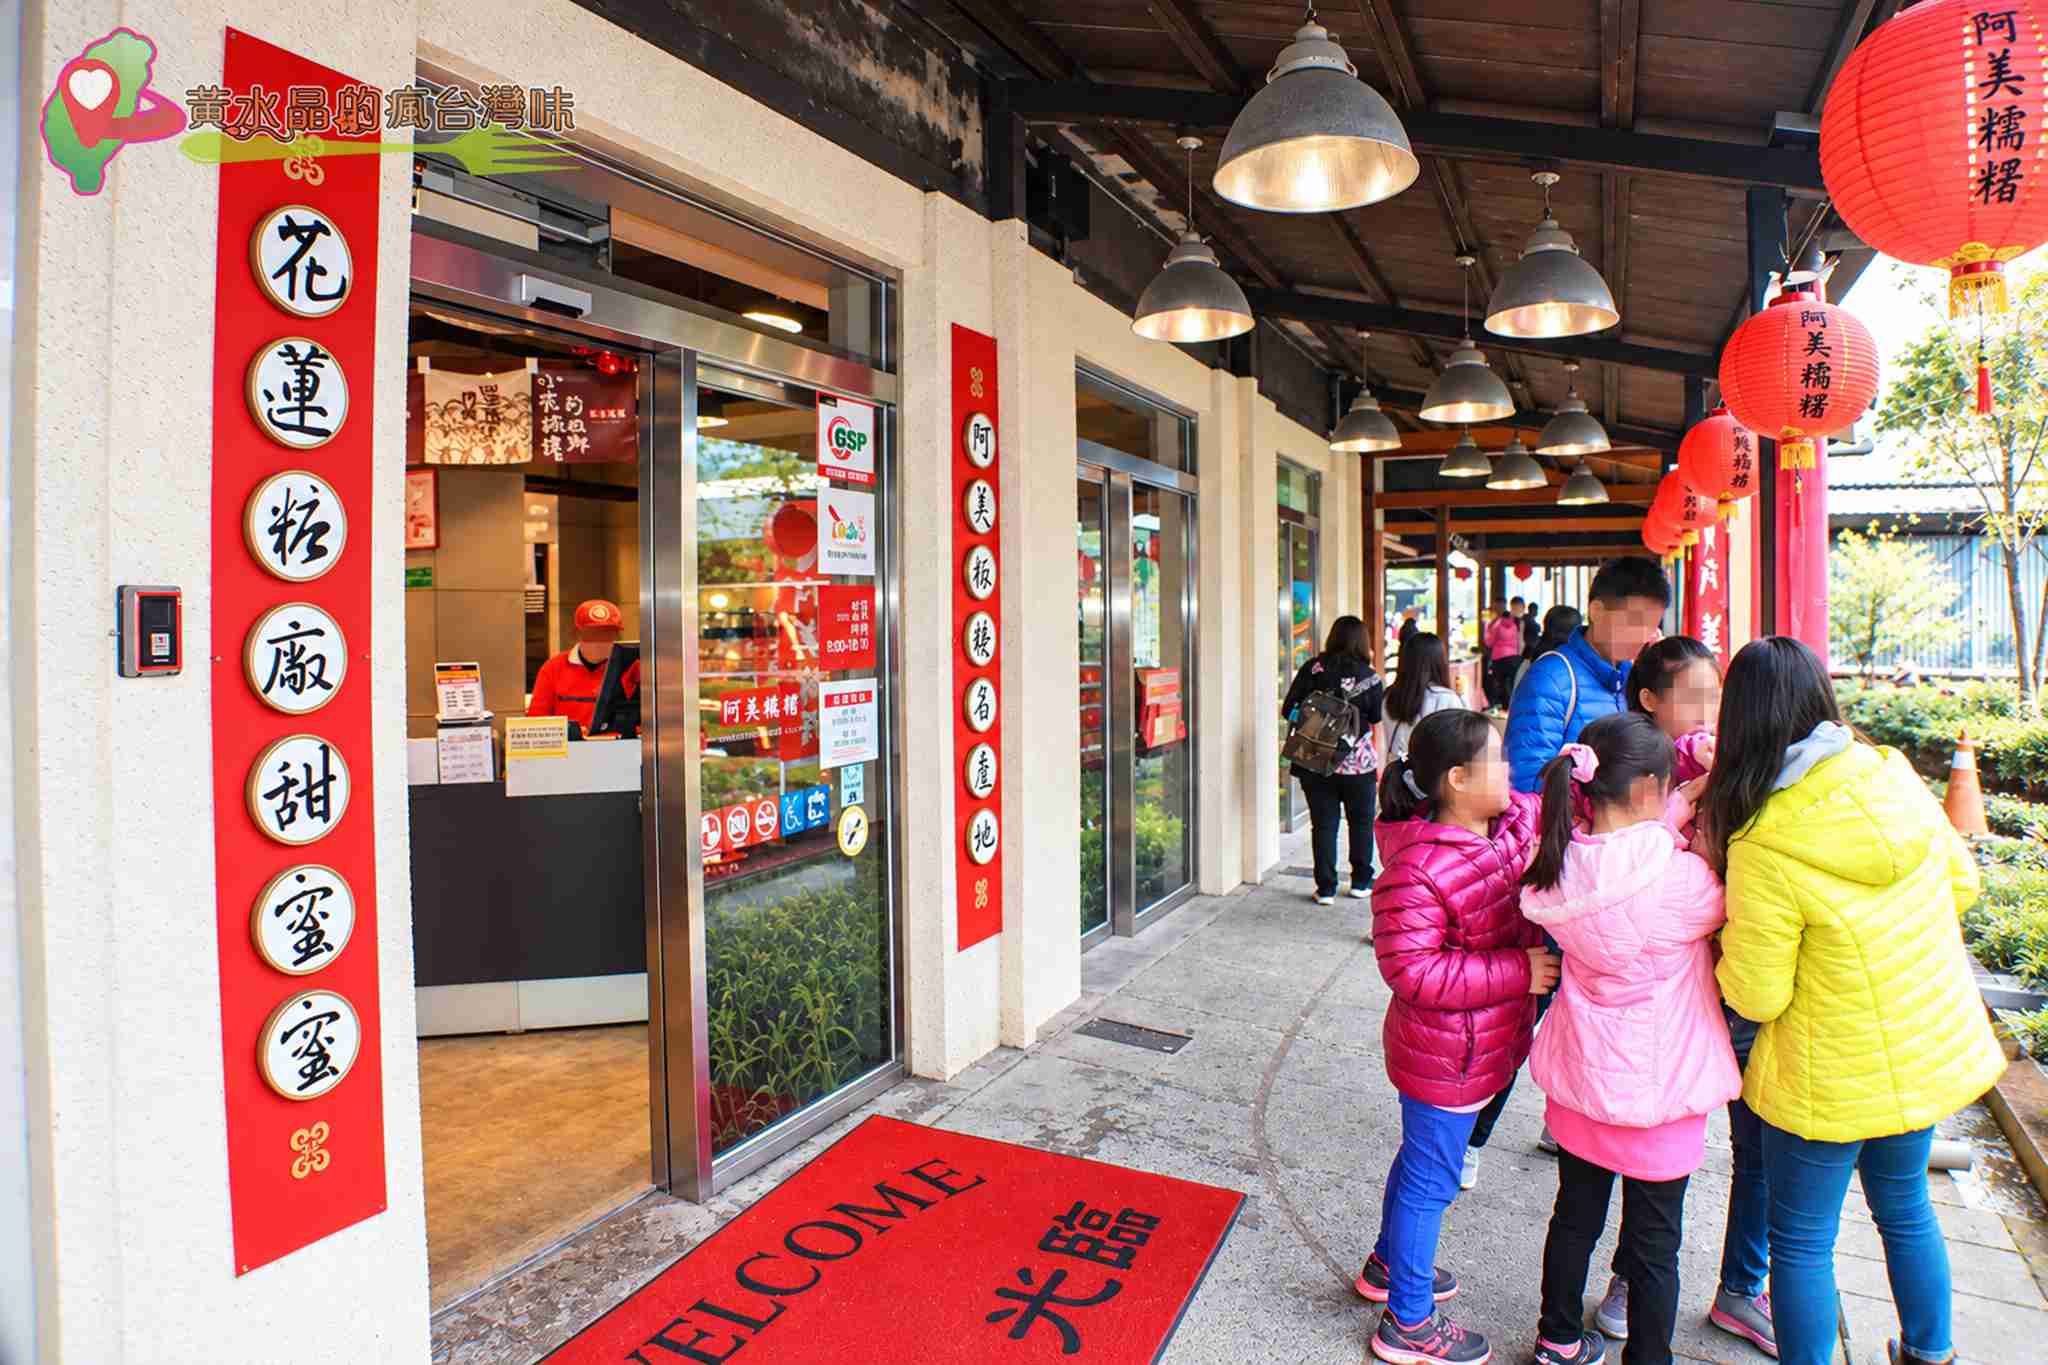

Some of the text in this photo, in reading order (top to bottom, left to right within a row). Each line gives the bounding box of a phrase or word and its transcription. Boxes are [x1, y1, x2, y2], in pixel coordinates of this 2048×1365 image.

[834, 426, 869, 452] GSP
[261, 214, 348, 1092] 花蓮糖廠甜蜜蜜
[624, 1159, 987, 1365] ELCOME
[985, 1199, 1162, 1355] 光臨
